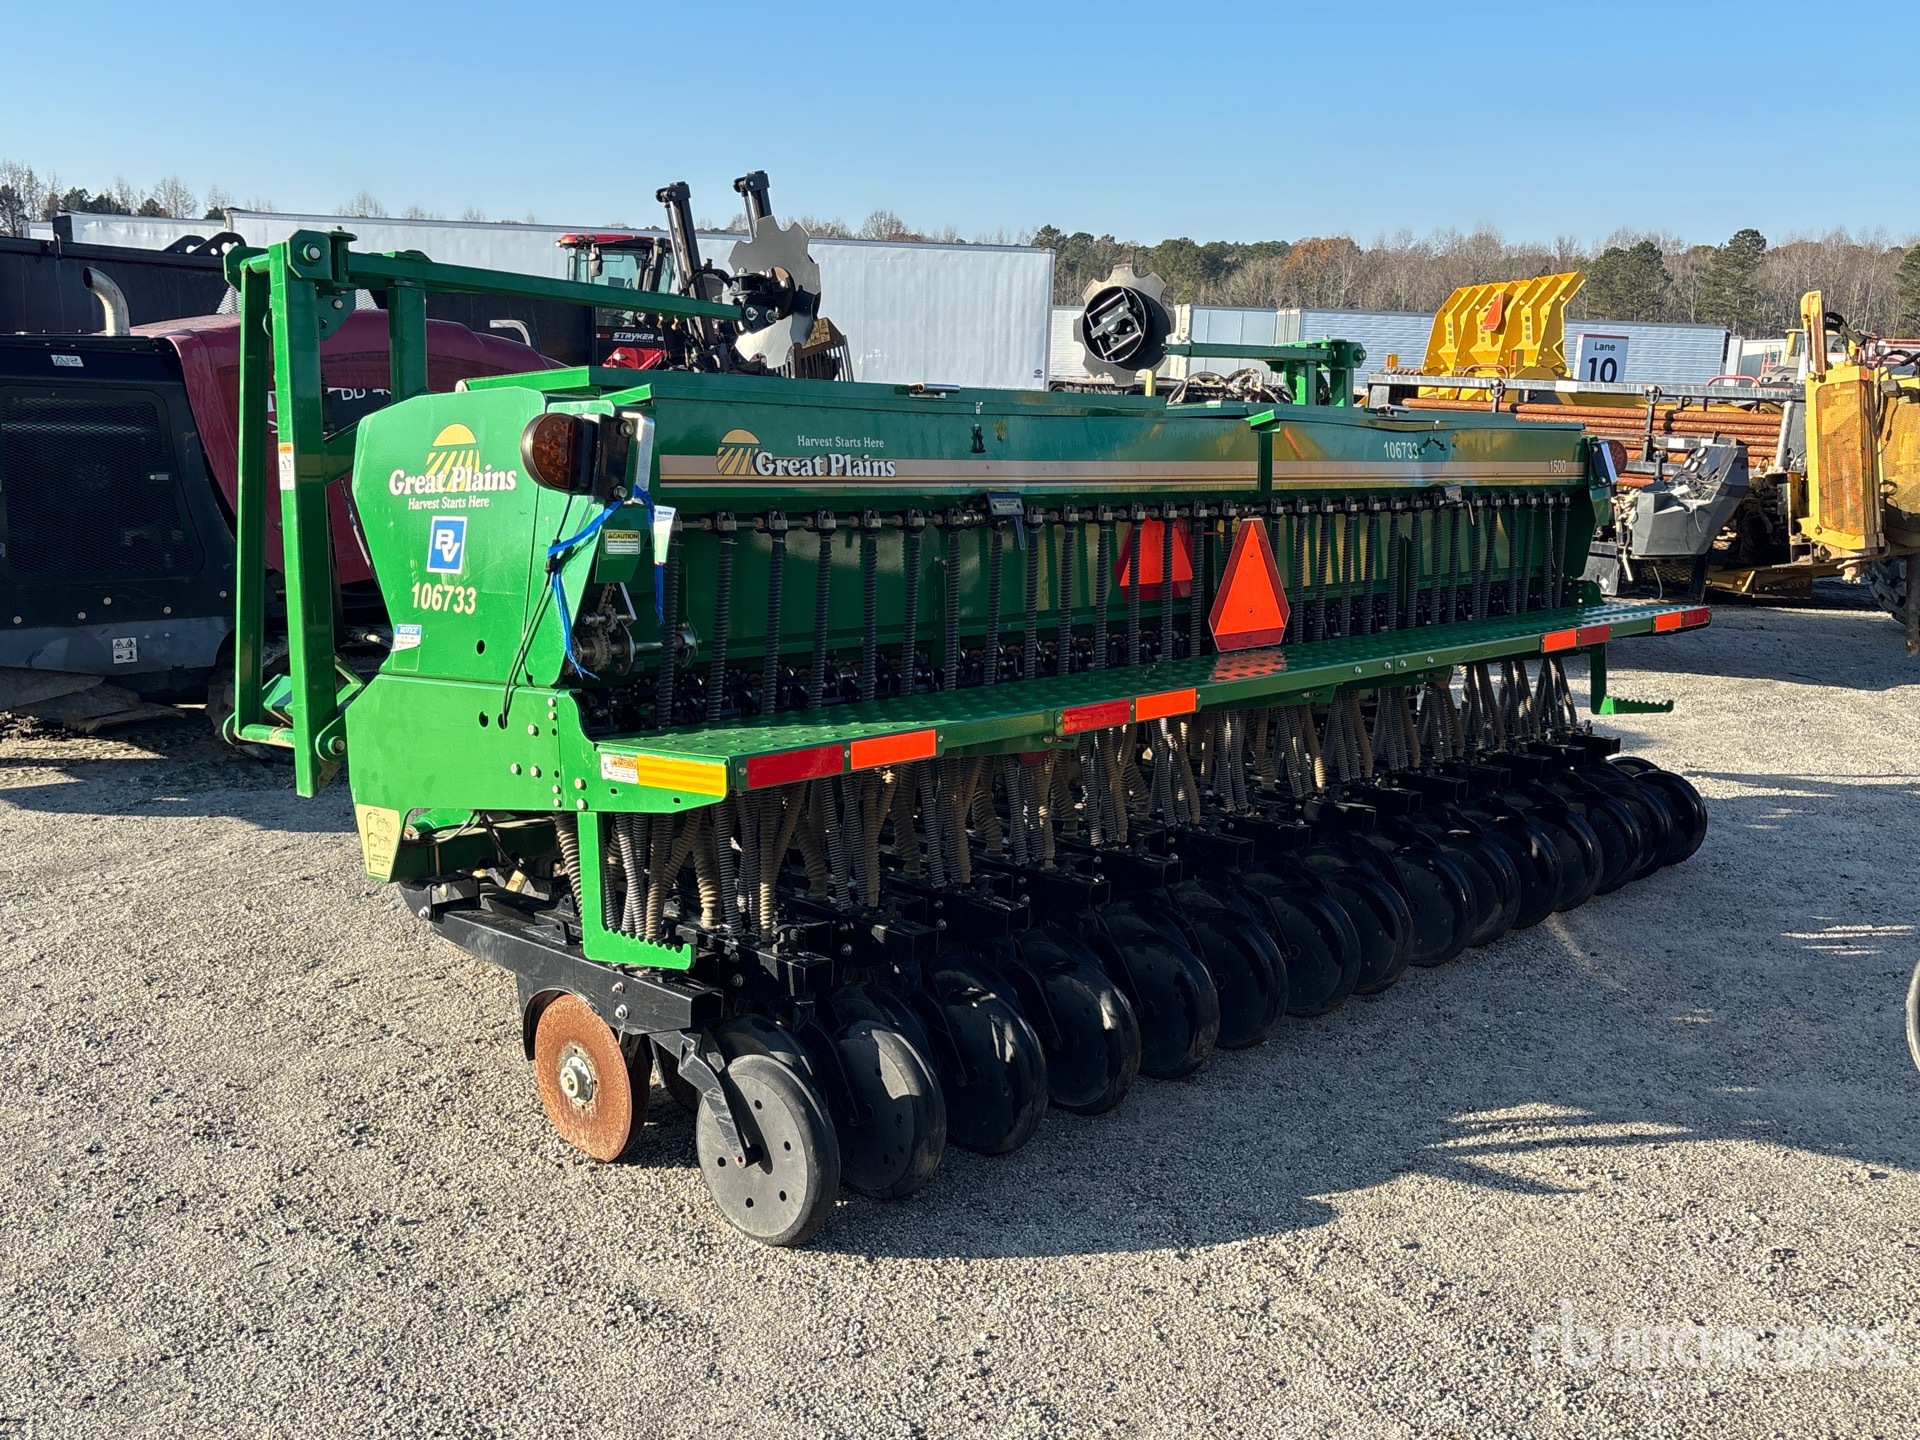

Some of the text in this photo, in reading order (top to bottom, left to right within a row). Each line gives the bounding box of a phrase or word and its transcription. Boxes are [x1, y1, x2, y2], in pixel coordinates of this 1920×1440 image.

[613, 332, 654, 341] STRYKER
[1594, 342, 1616, 351] Lane
[1588, 357, 1618, 383] 10
[797, 435, 885, 448] Harvest Starts Here
[1383, 441, 1419, 460] 106733
[754, 451, 896, 477] Great Plains
[1549, 460, 1567, 474] 1500
[389, 464, 517, 496] Great Plains
[407, 495, 490, 511] Harvest Starts Here
[411, 582, 477, 615] 106733
